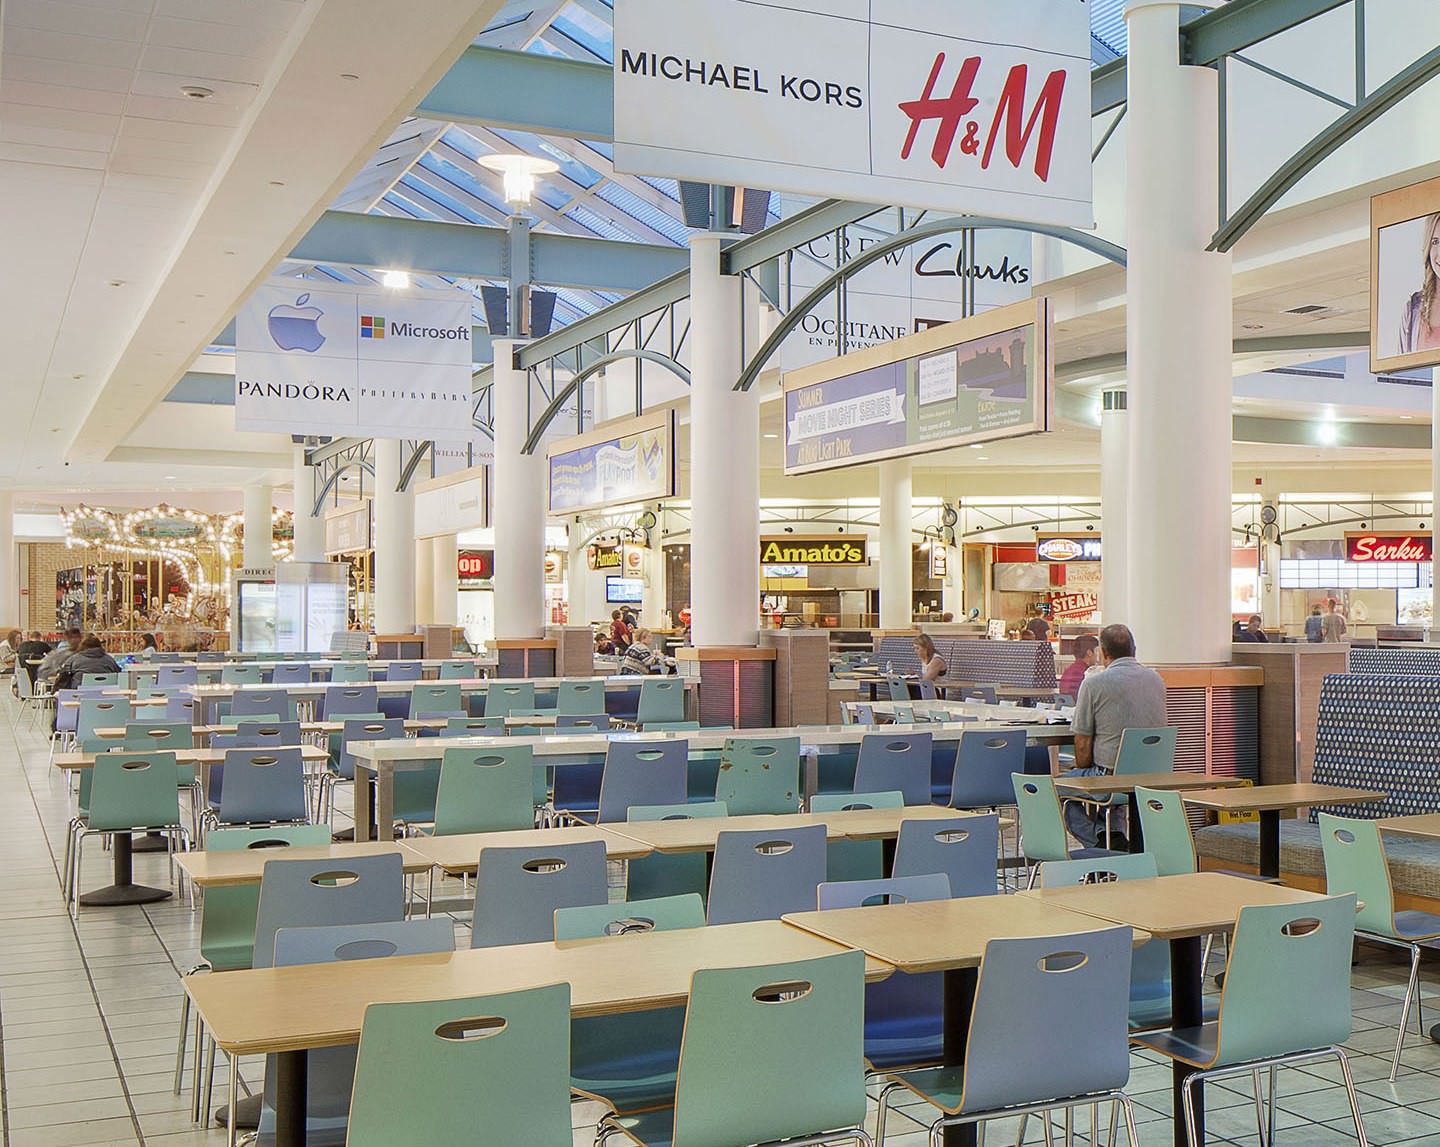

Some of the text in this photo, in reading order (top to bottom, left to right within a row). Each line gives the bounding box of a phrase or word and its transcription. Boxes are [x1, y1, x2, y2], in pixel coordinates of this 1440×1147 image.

[621, 48, 863, 109] MICHAEL KORS
[898, 52, 1067, 183] H&M
[914, 243, 1029, 284] Clarks
[391, 322, 470, 341] Microsoft
[809, 337, 823, 346] EN
[238, 380, 351, 402] PANDORA
[827, 403, 858, 430] NIGHT
[859, 395, 892, 422] SERIES
[762, 542, 862, 562] Amato's
[1352, 537, 1425, 561] Sarku
[458, 558, 481, 573] op
[1052, 591, 1097, 613] STEAK!
